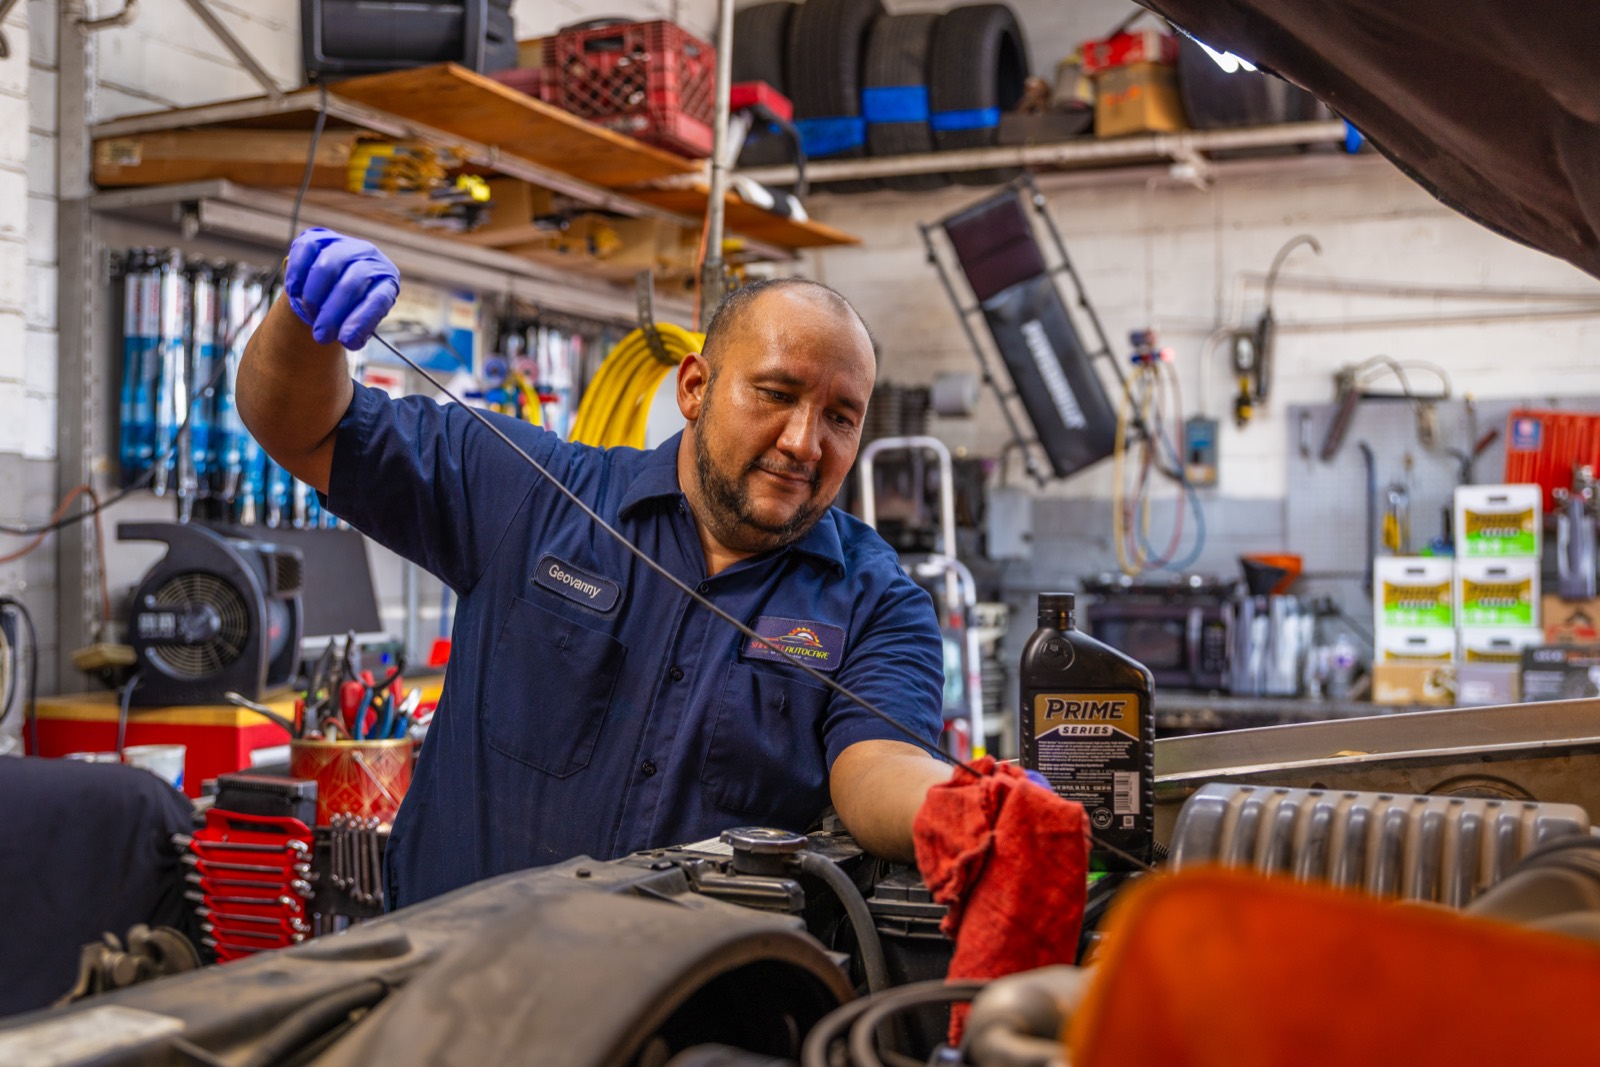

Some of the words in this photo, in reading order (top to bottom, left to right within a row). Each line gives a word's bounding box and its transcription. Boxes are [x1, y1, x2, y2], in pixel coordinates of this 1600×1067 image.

[548, 564, 602, 599] Geovanny
[784, 645, 831, 660] AUTOCARE
[1044, 697, 1127, 721] PRIME
[1062, 726, 1109, 734] SERIES
